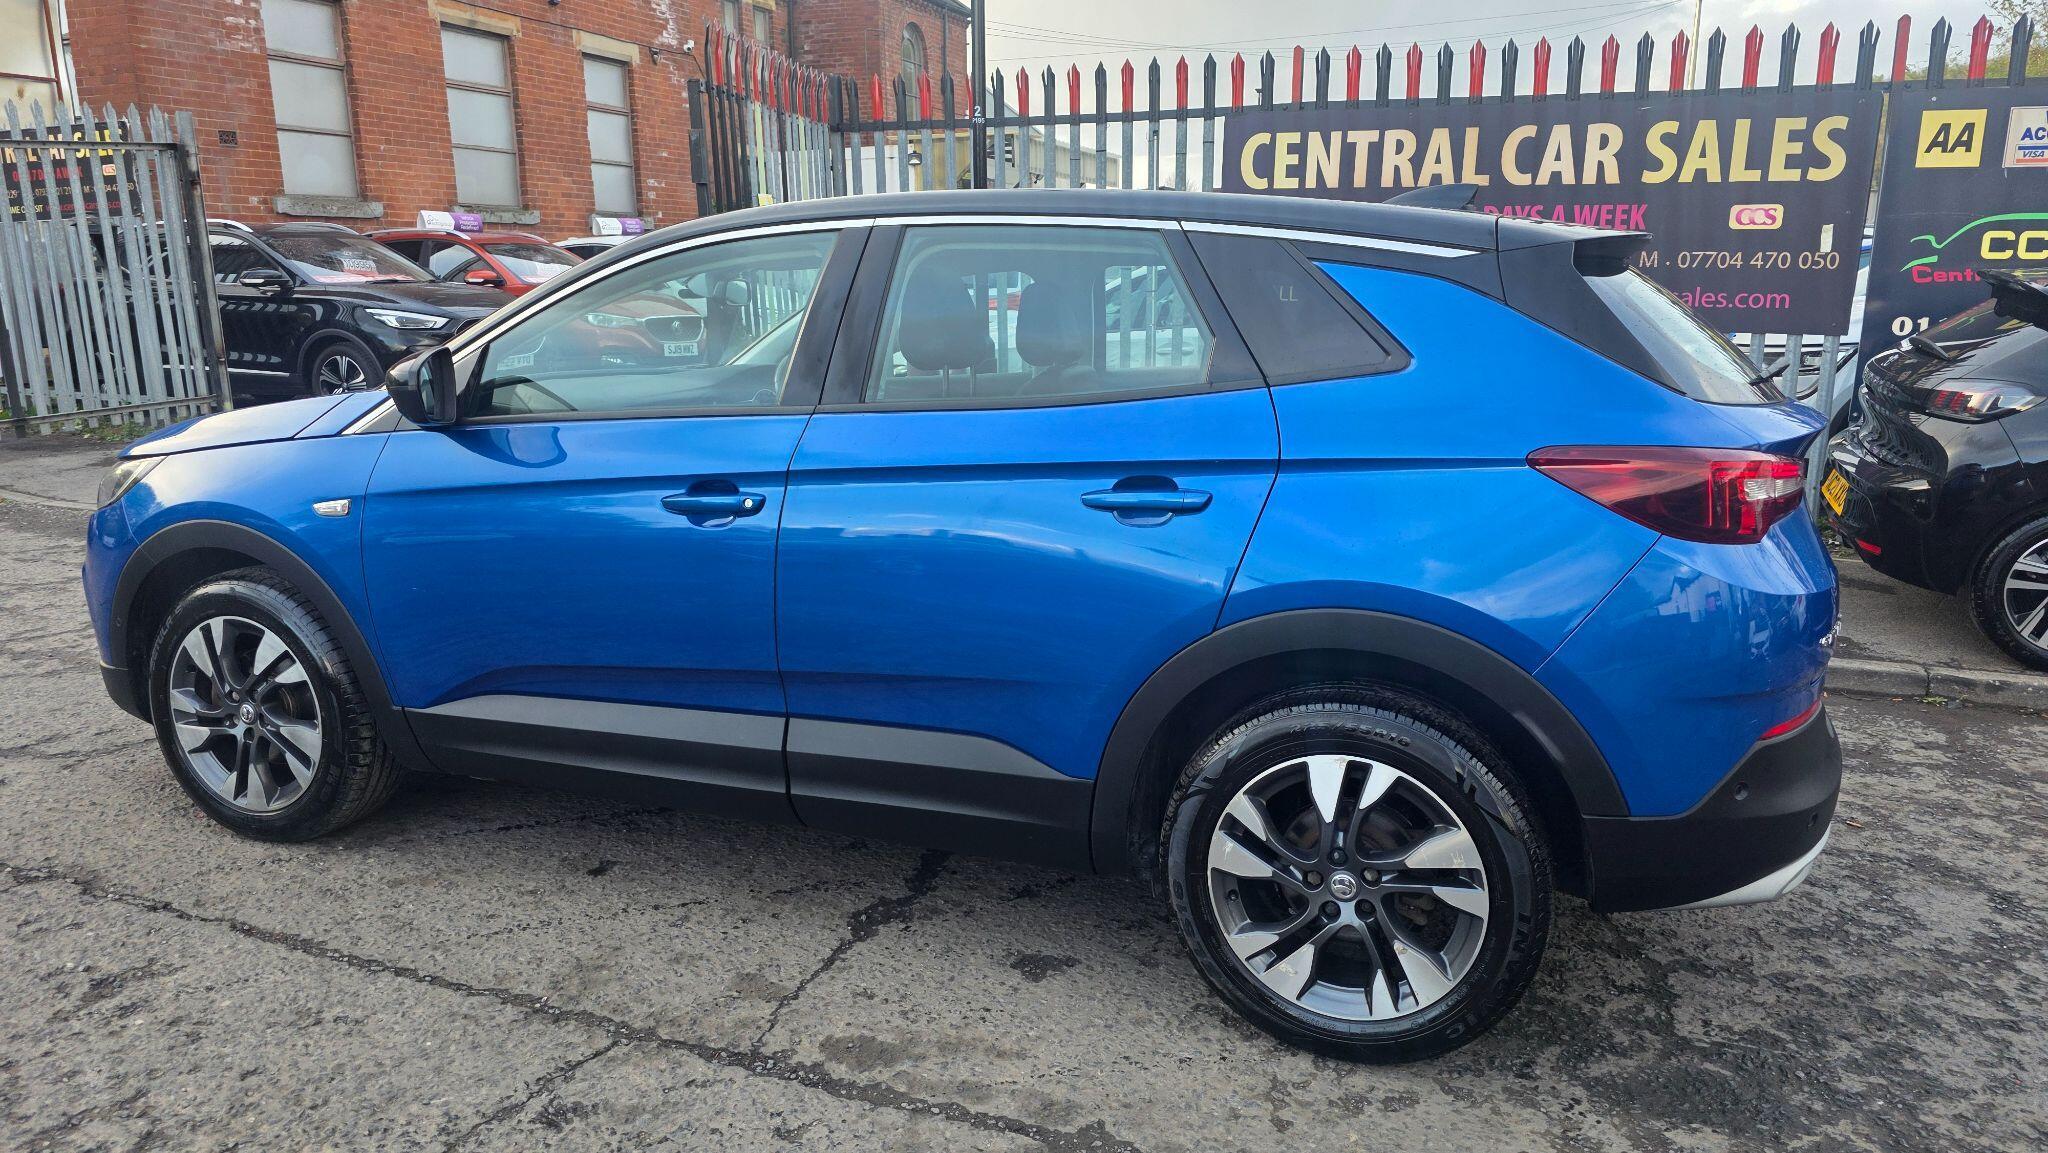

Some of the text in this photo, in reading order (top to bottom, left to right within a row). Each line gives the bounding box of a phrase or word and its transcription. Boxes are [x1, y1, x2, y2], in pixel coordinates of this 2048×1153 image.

[974, 105, 981, 117] 2
[1924, 122, 1975, 154] AA
[1240, 116, 1849, 189] CENTRAL CAR SALES
[2022, 150, 2045, 158] VISA
[1574, 203, 1648, 231] WEEK
[1639, 250, 1840, 270] M 07704 470 050
[1672, 286, 1790, 310] ales.com
